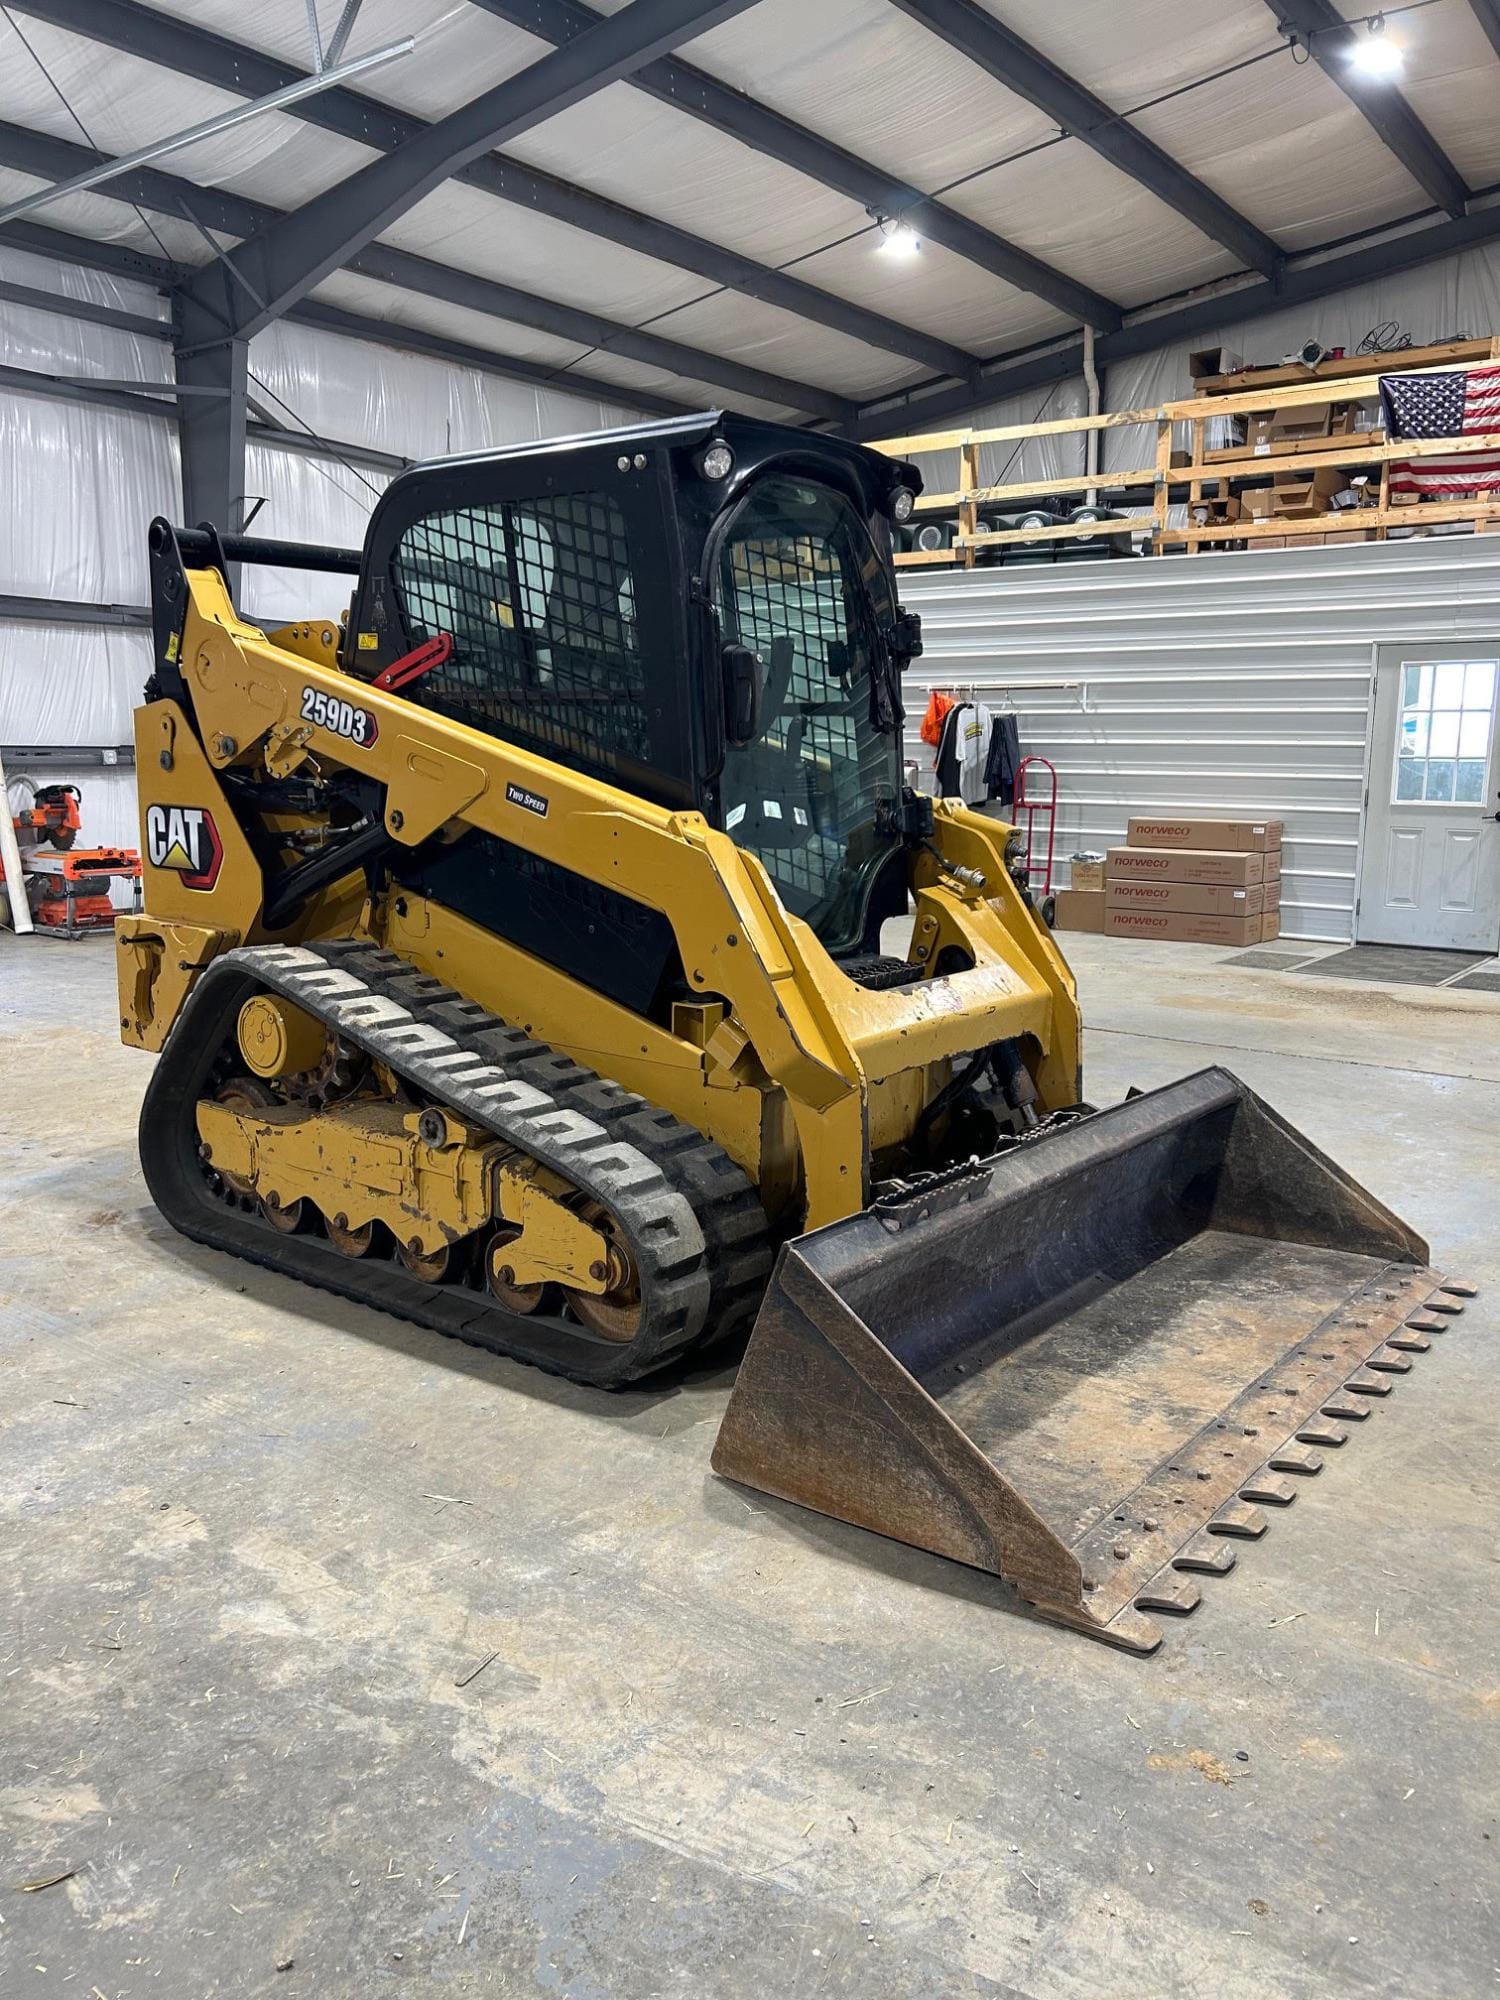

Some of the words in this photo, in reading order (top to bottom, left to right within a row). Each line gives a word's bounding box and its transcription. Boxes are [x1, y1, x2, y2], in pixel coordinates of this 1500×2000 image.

[301, 687, 367, 743] 259D3
[1136, 825, 1191, 836] norweco
[147, 805, 203, 870] CAT
[1114, 857, 1169, 868] norweco
[1114, 887, 1169, 898] norweco
[1113, 915, 1168, 927] norweco
